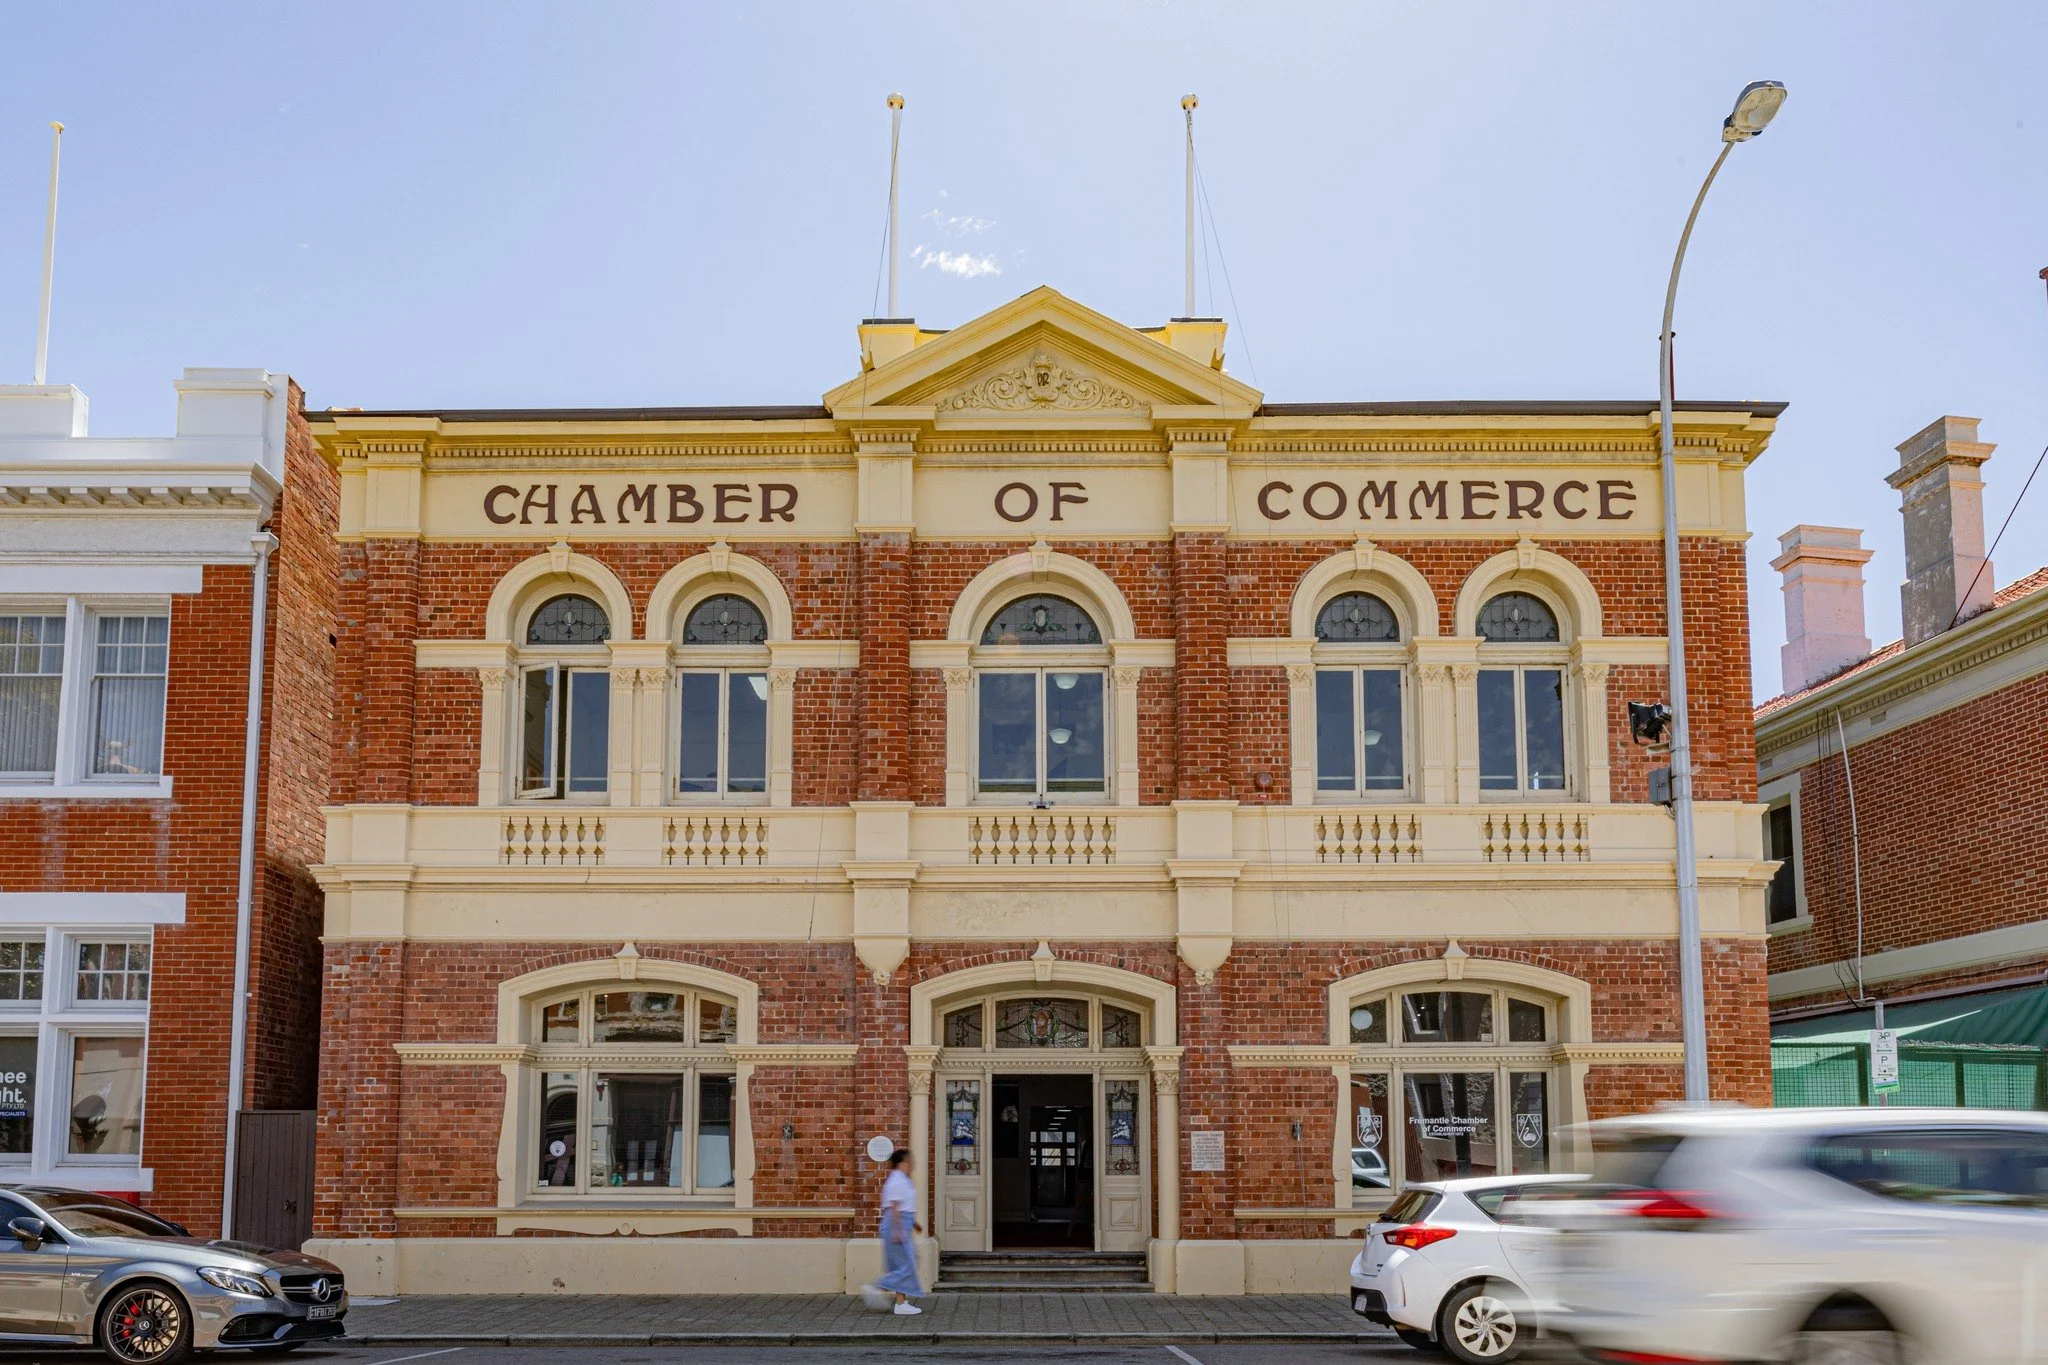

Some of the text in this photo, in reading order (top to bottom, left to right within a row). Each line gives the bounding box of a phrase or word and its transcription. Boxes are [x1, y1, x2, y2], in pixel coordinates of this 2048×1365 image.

[484, 480, 1637, 525] CHAMBER OF COMMERCE
[1881, 1055, 1888, 1064] P
[1409, 1116, 1489, 1125] Fremantle Chamber
[1423, 1125, 1477, 1133] of Commerce
